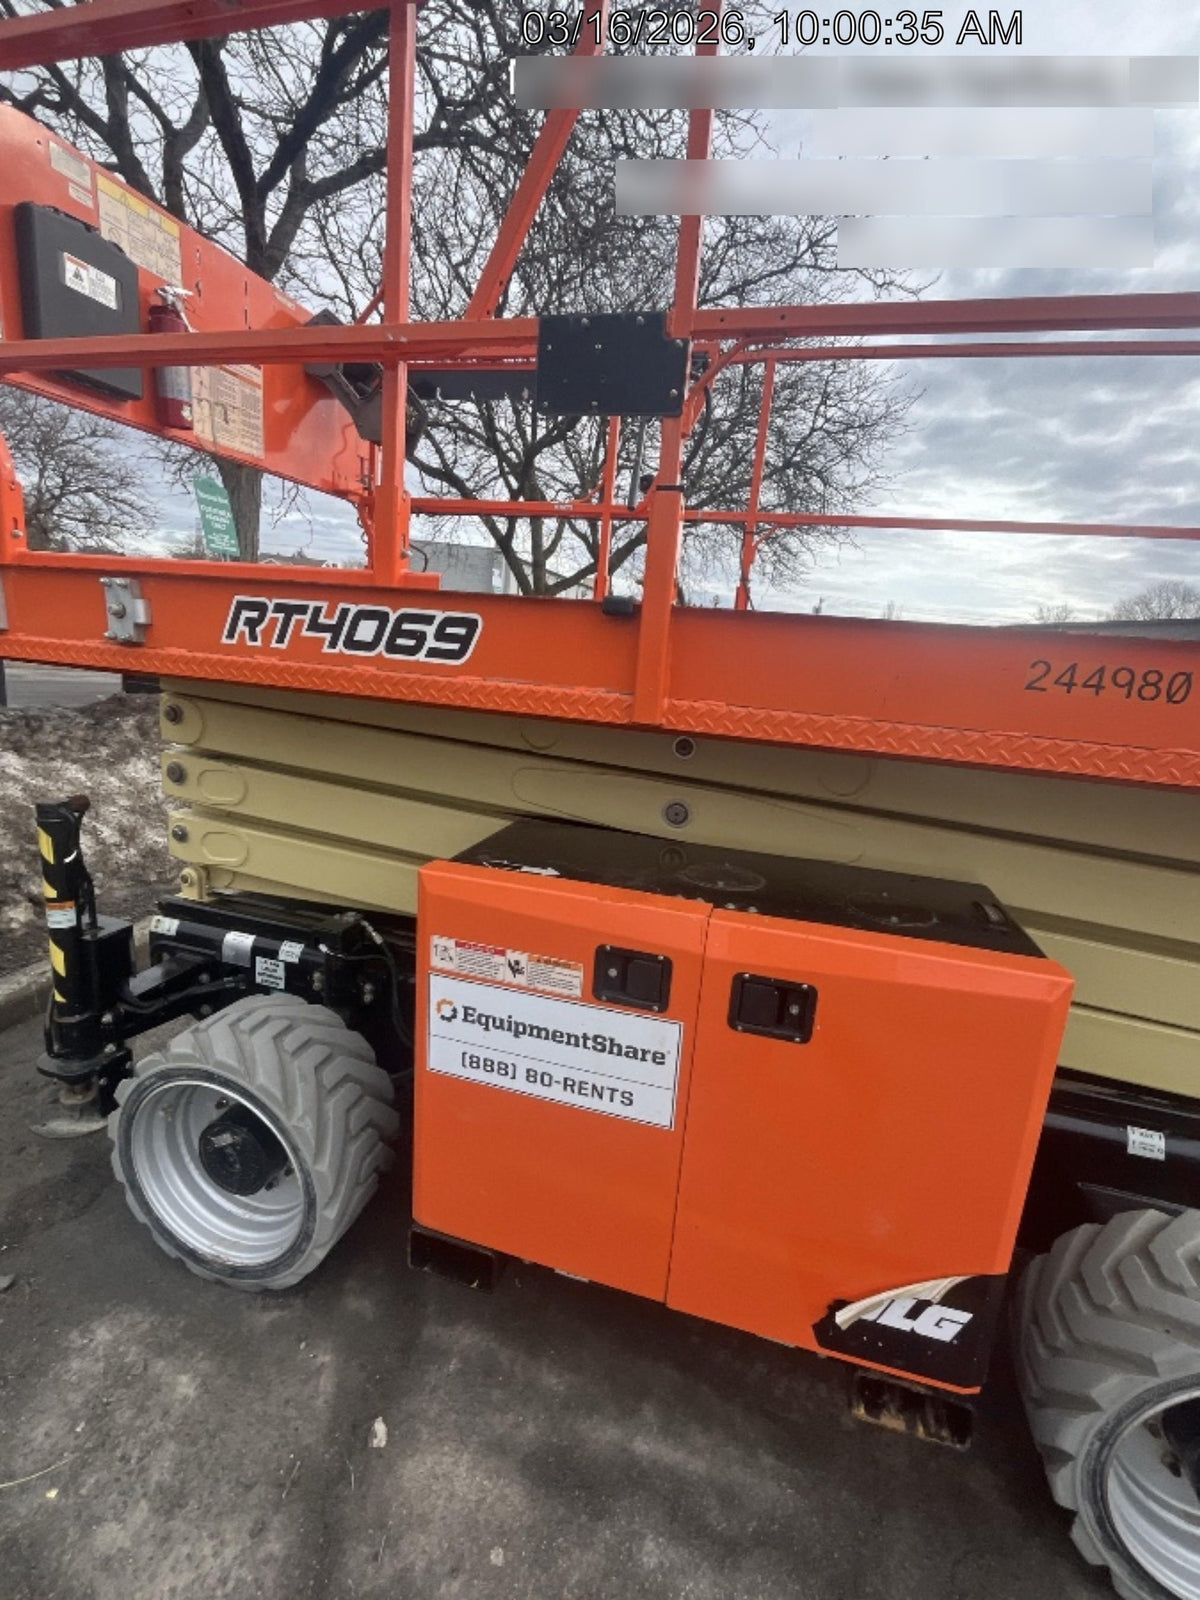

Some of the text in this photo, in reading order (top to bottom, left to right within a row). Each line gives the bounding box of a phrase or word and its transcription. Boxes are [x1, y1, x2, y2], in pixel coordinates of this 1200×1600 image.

[221, 595, 483, 666] RT4069
[1024, 659, 1194, 705] 244980
[461, 1004, 667, 1067] EquipmentShare
[525, 1067, 634, 1108] 80-RENTS
